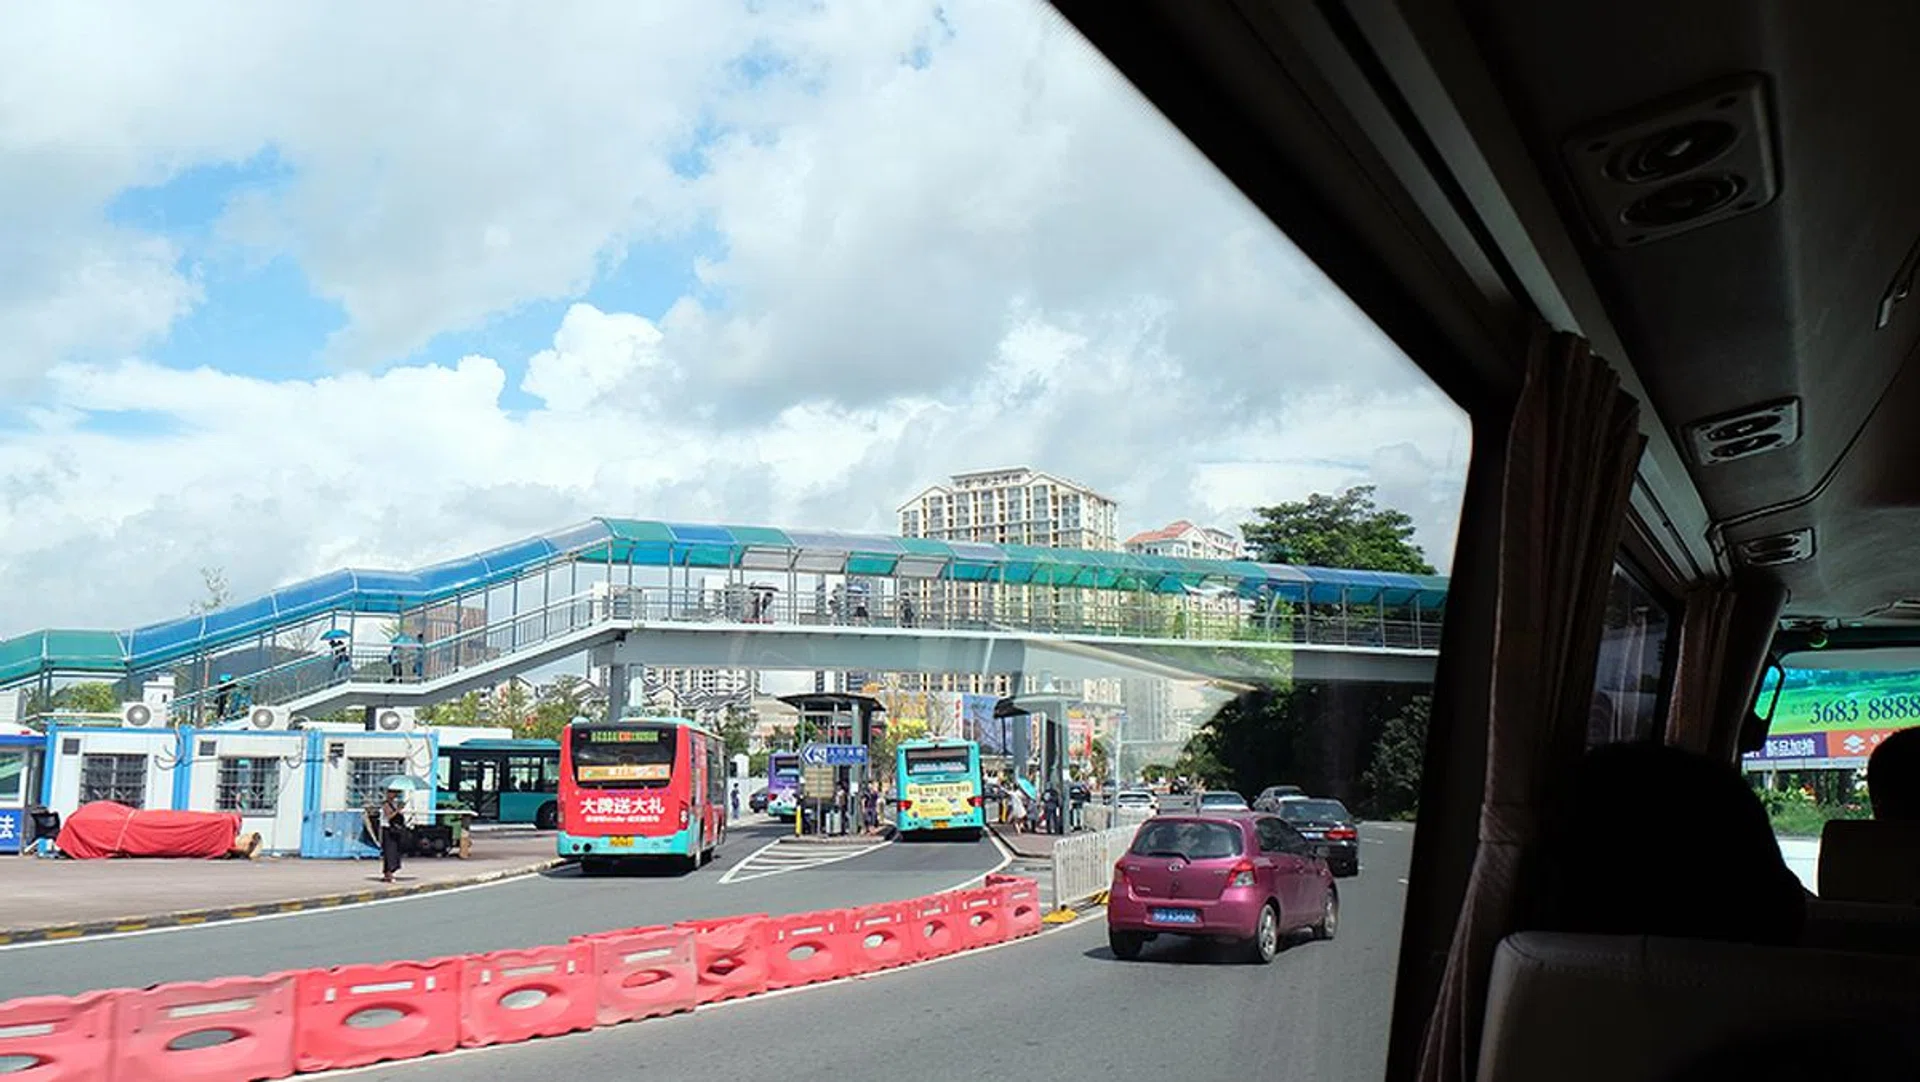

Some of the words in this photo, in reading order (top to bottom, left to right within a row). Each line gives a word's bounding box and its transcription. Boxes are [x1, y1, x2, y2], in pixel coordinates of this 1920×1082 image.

[1810, 699, 1859, 724] 3683
[1868, 694, 1920, 721] 8888
[580, 797, 665, 815] 大牌送大礼
